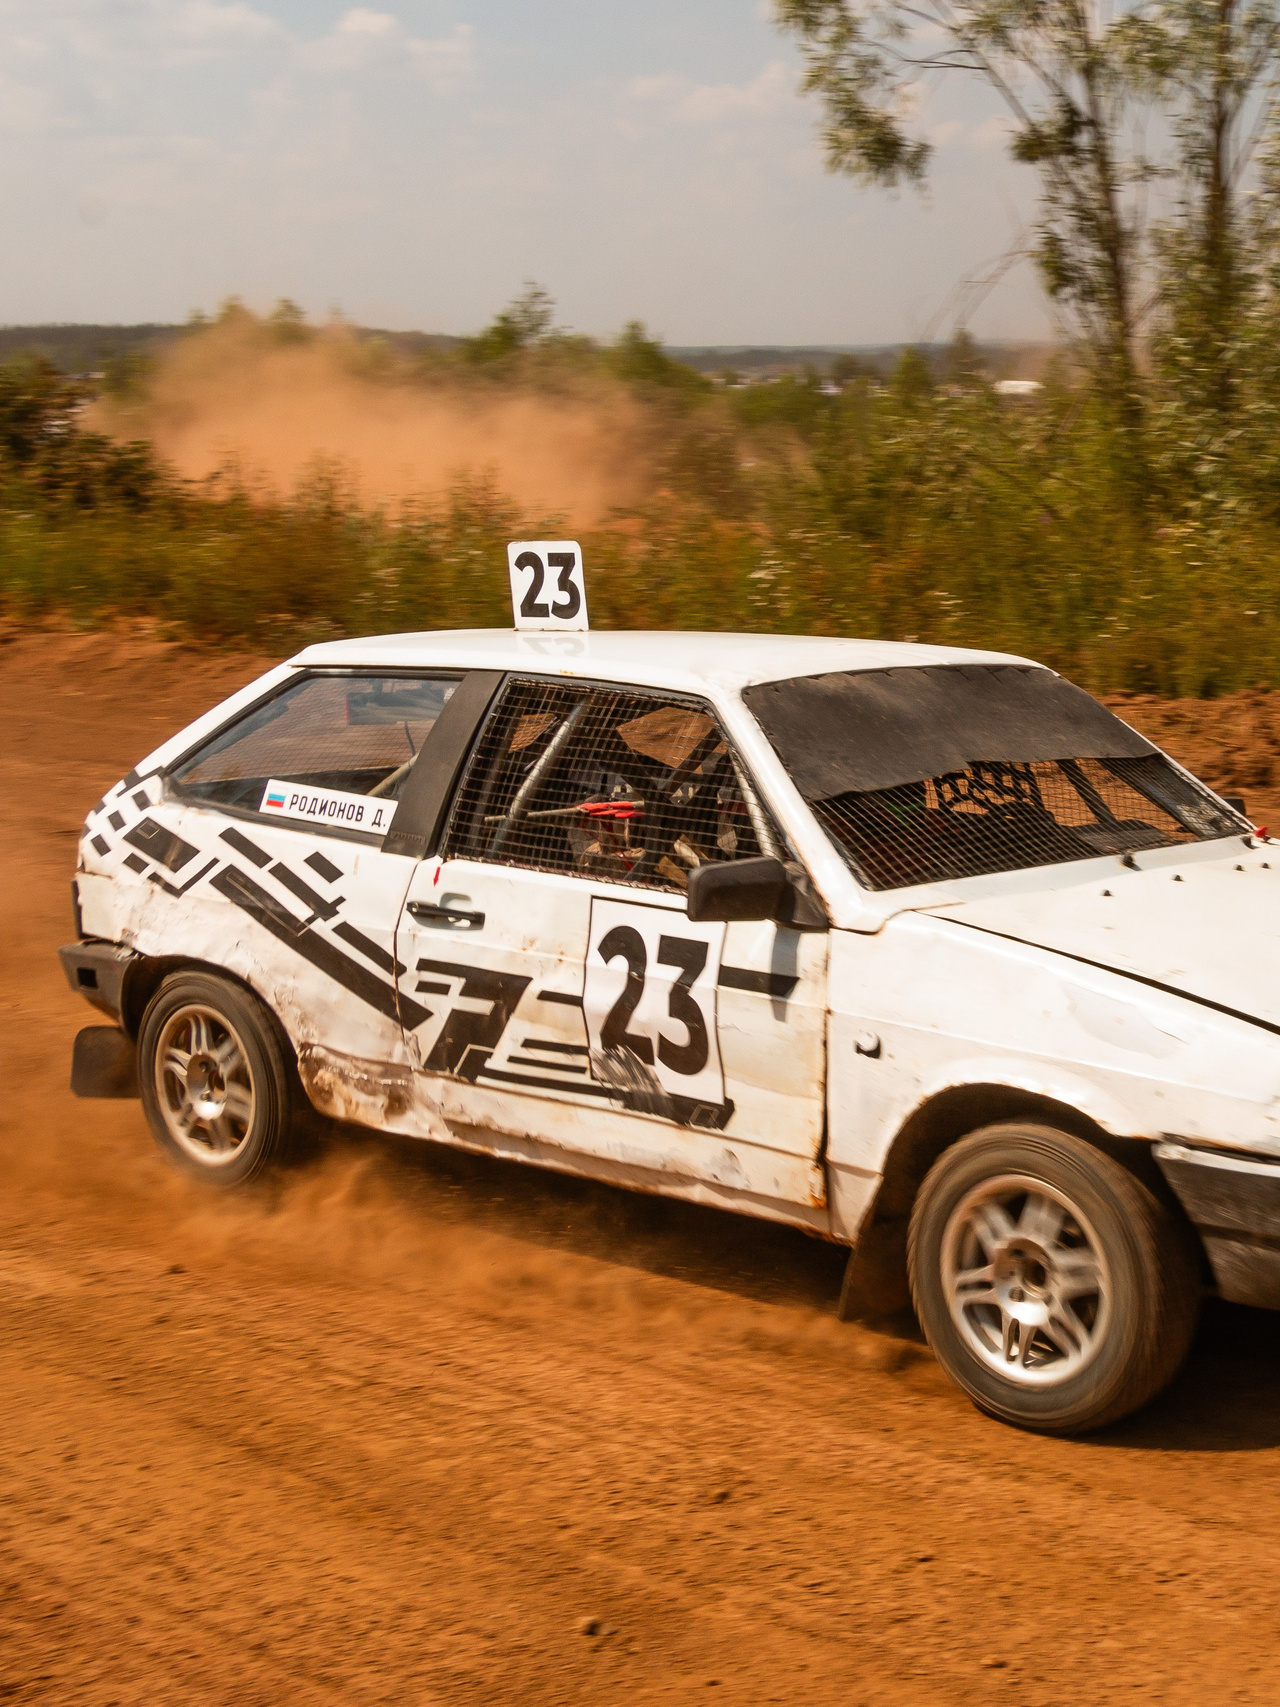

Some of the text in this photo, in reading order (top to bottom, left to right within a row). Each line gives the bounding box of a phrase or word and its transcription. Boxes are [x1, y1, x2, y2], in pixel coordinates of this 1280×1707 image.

[514, 551, 581, 620] 23
[289, 794, 386, 828] РОДИОНОВ Д.
[597, 925, 709, 1075] 23
